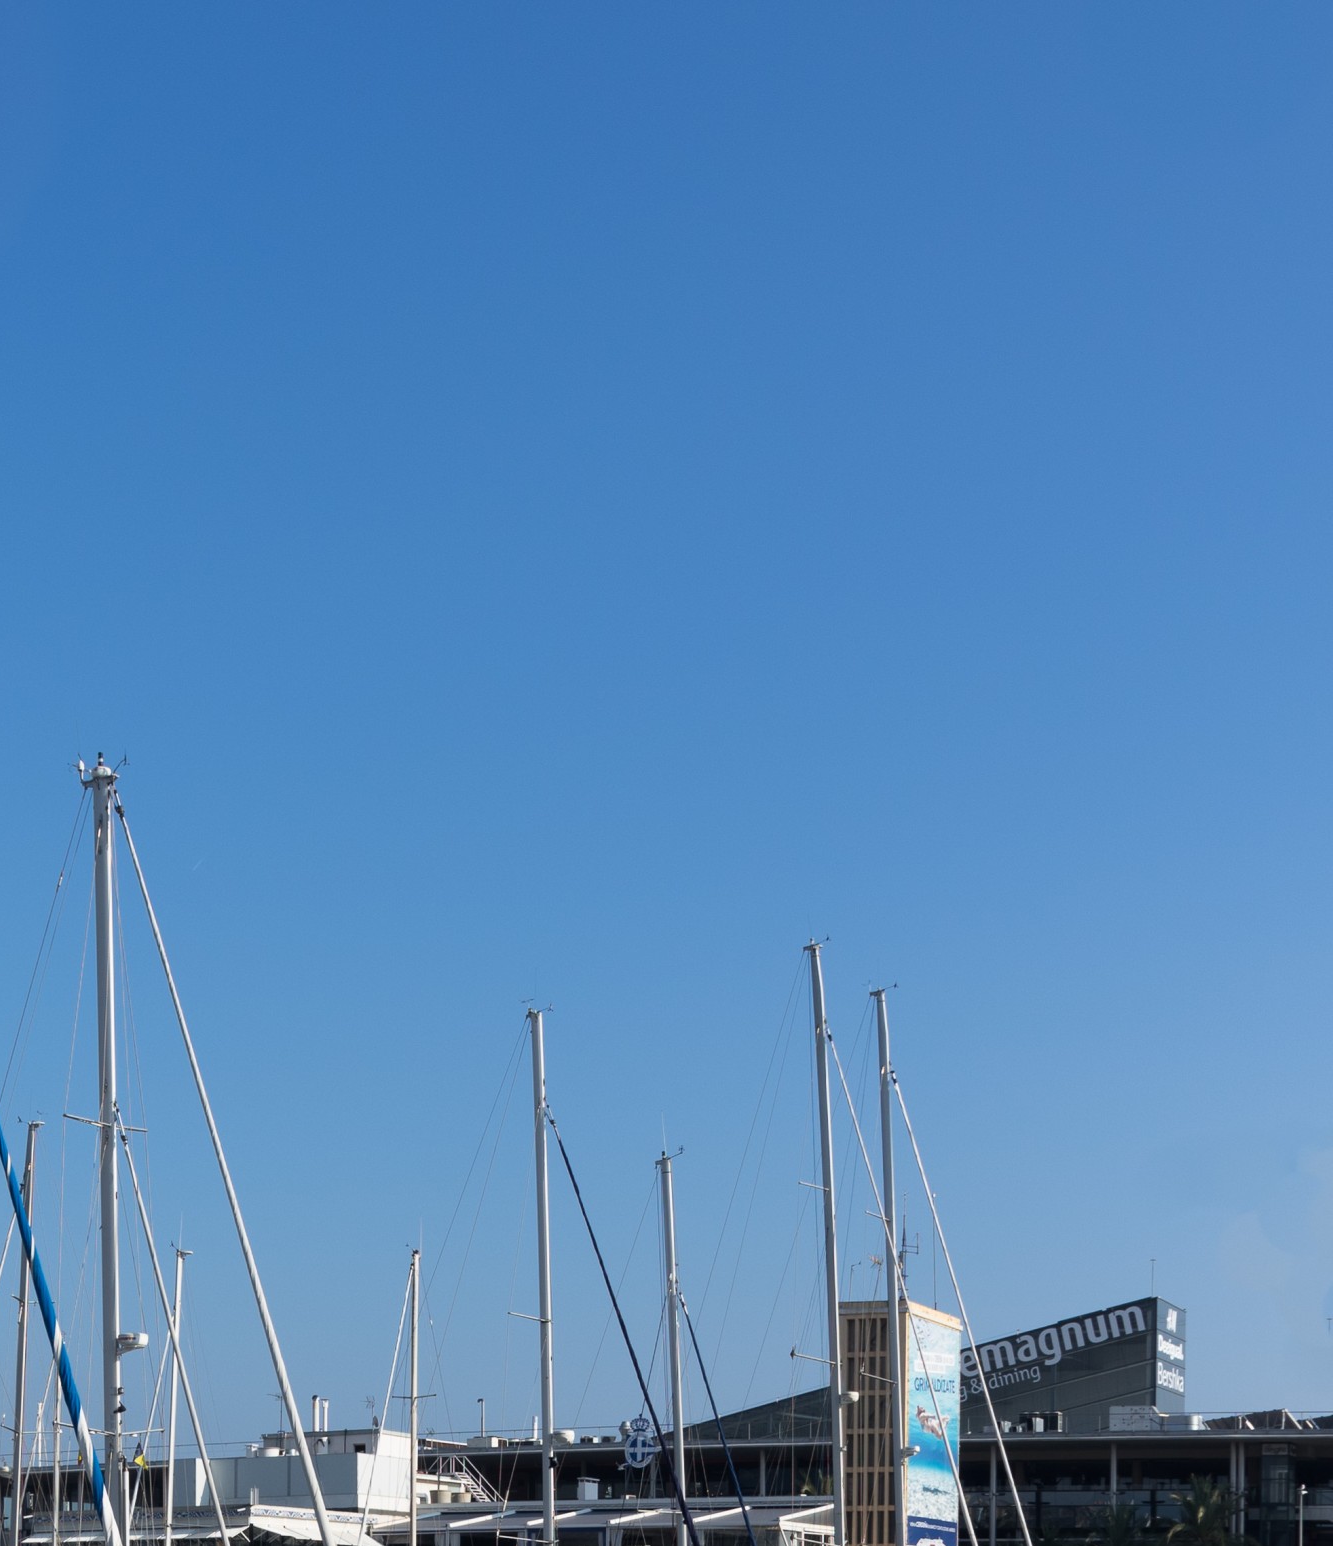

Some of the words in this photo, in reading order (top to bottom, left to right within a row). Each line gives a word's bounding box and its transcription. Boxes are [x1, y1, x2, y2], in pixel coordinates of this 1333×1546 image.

[960, 1305, 1146, 1378] emagnum
[988, 1365, 1042, 1390] dining
[1157, 1361, 1184, 1393] Bershka
